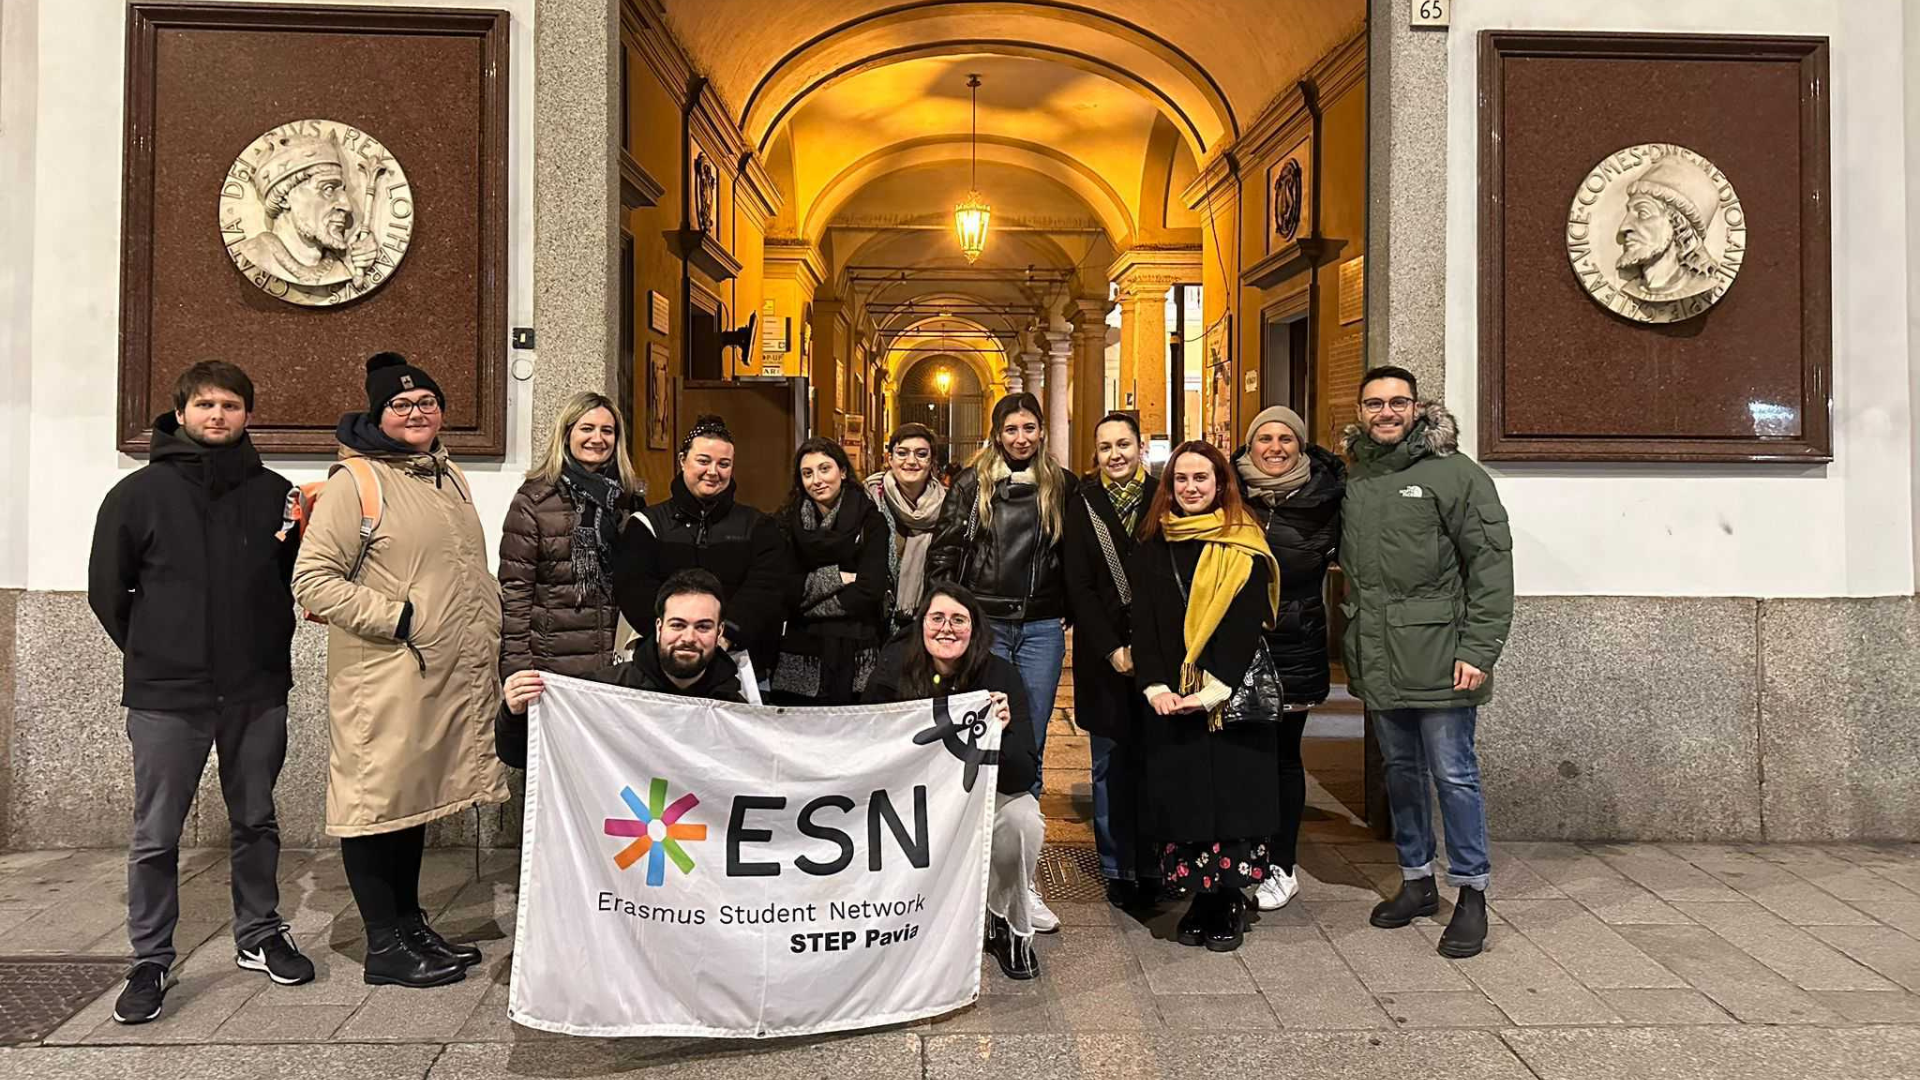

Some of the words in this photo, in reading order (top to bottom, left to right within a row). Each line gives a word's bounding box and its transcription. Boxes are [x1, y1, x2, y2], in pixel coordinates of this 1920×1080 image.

[1420, 0, 1442, 19] 65
[727, 785, 929, 876] ESN
[599, 892, 705, 924] Erasmus
[720, 903, 816, 924] Student
[831, 893, 925, 920] Network
[790, 931, 857, 953] STEP
[866, 923, 919, 949] Pavia
